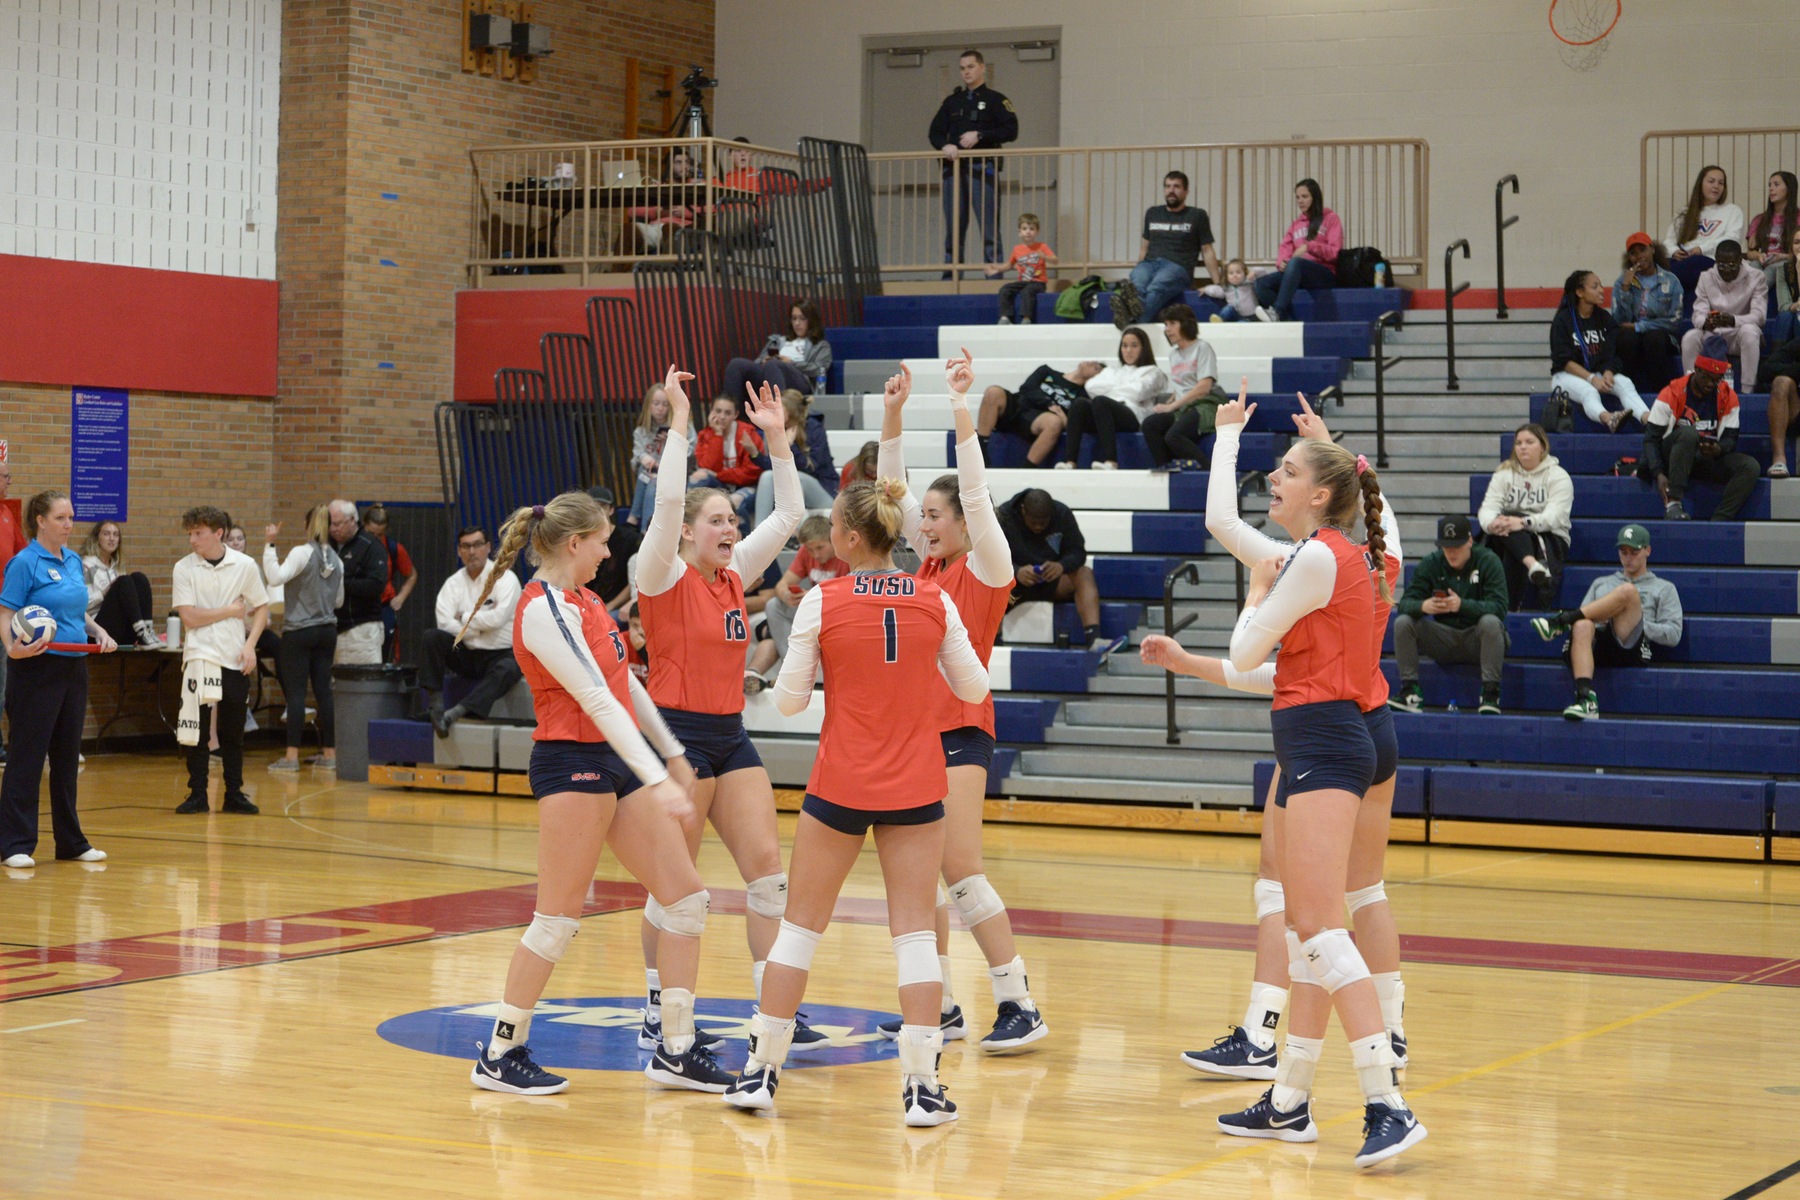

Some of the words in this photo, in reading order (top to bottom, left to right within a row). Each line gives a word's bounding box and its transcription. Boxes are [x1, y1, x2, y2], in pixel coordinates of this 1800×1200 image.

[1507, 488, 1544, 507] SVSU
[853, 576, 915, 597] SVSU
[724, 608, 747, 641] 16
[883, 607, 897, 663] 1
